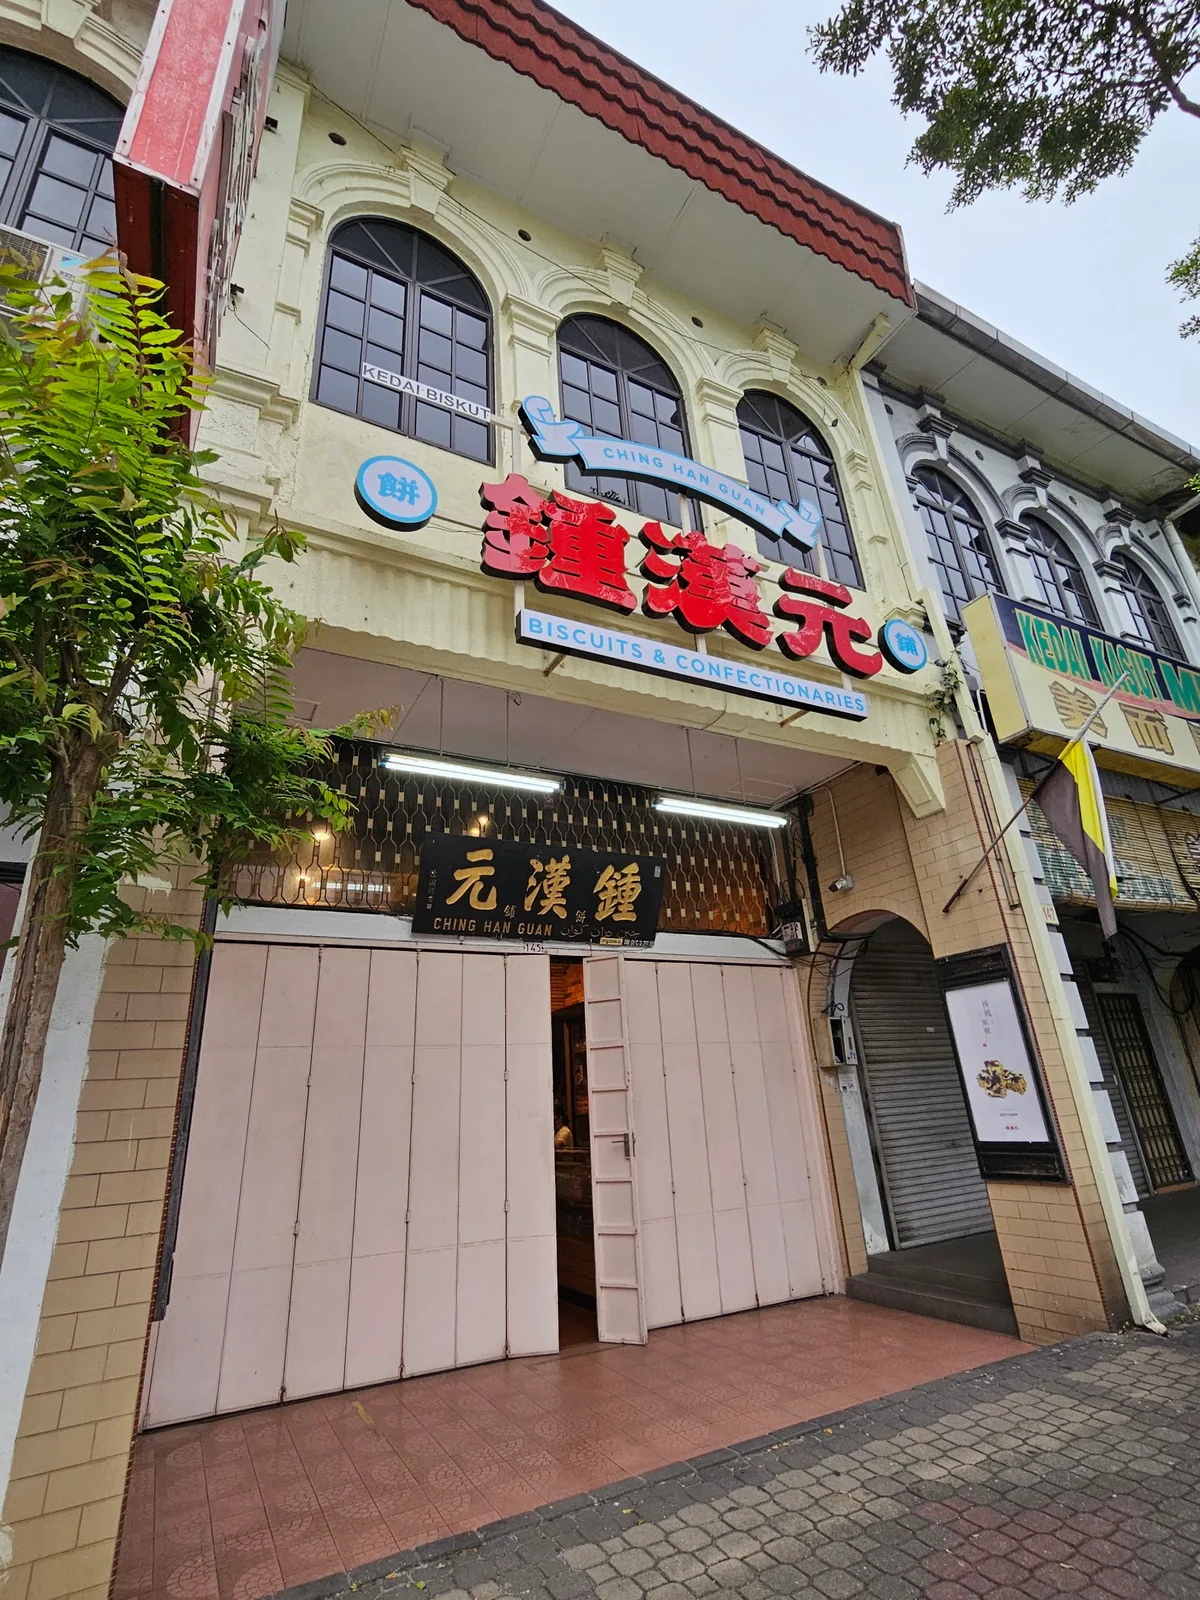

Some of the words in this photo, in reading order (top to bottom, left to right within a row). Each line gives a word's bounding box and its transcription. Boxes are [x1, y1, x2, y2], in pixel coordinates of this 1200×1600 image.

[363, 364, 421, 395] KEDAI
[426, 388, 490, 421] BISKUT
[603, 446, 663, 469] CHING
[672, 462, 711, 487] HAN
[719, 483, 766, 517] GUAN
[528, 617, 643, 659] BISCUITS
[653, 648, 666, 665] &
[676, 654, 866, 712] CONFECTIONARIES
[1014, 608, 1093, 682] KEDAI
[1087, 634, 1165, 702] KASUT
[1157, 658, 1200, 716] M
[433, 917, 477, 932] CHING
[483, 920, 512, 935] HAN
[517, 922, 553, 937] GUAN
[1042, 906, 1056, 921] 147
[525, 943, 542, 953] 145
